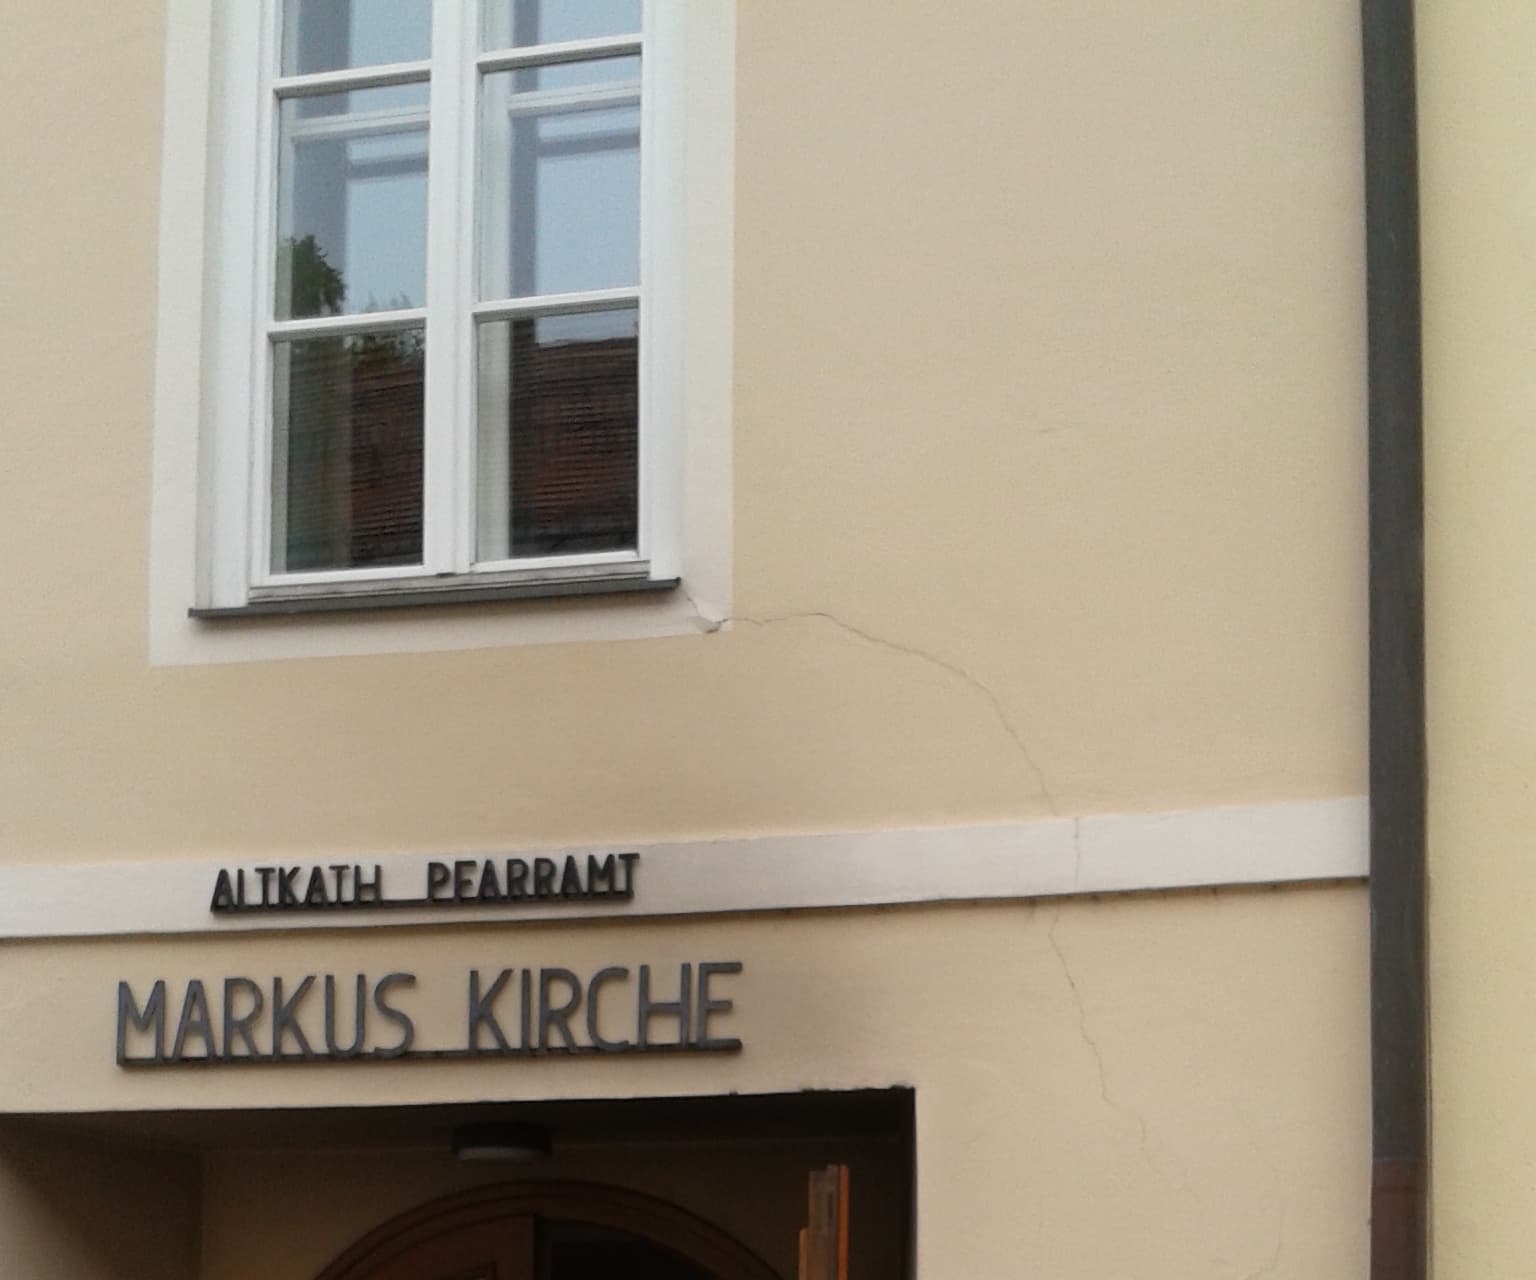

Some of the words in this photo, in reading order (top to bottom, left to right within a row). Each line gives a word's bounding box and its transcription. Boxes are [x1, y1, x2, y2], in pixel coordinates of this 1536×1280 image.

[210, 864, 382, 912] ALTKATH
[116, 972, 417, 1065] MARKUS
[468, 961, 743, 1054] KIRCHE
